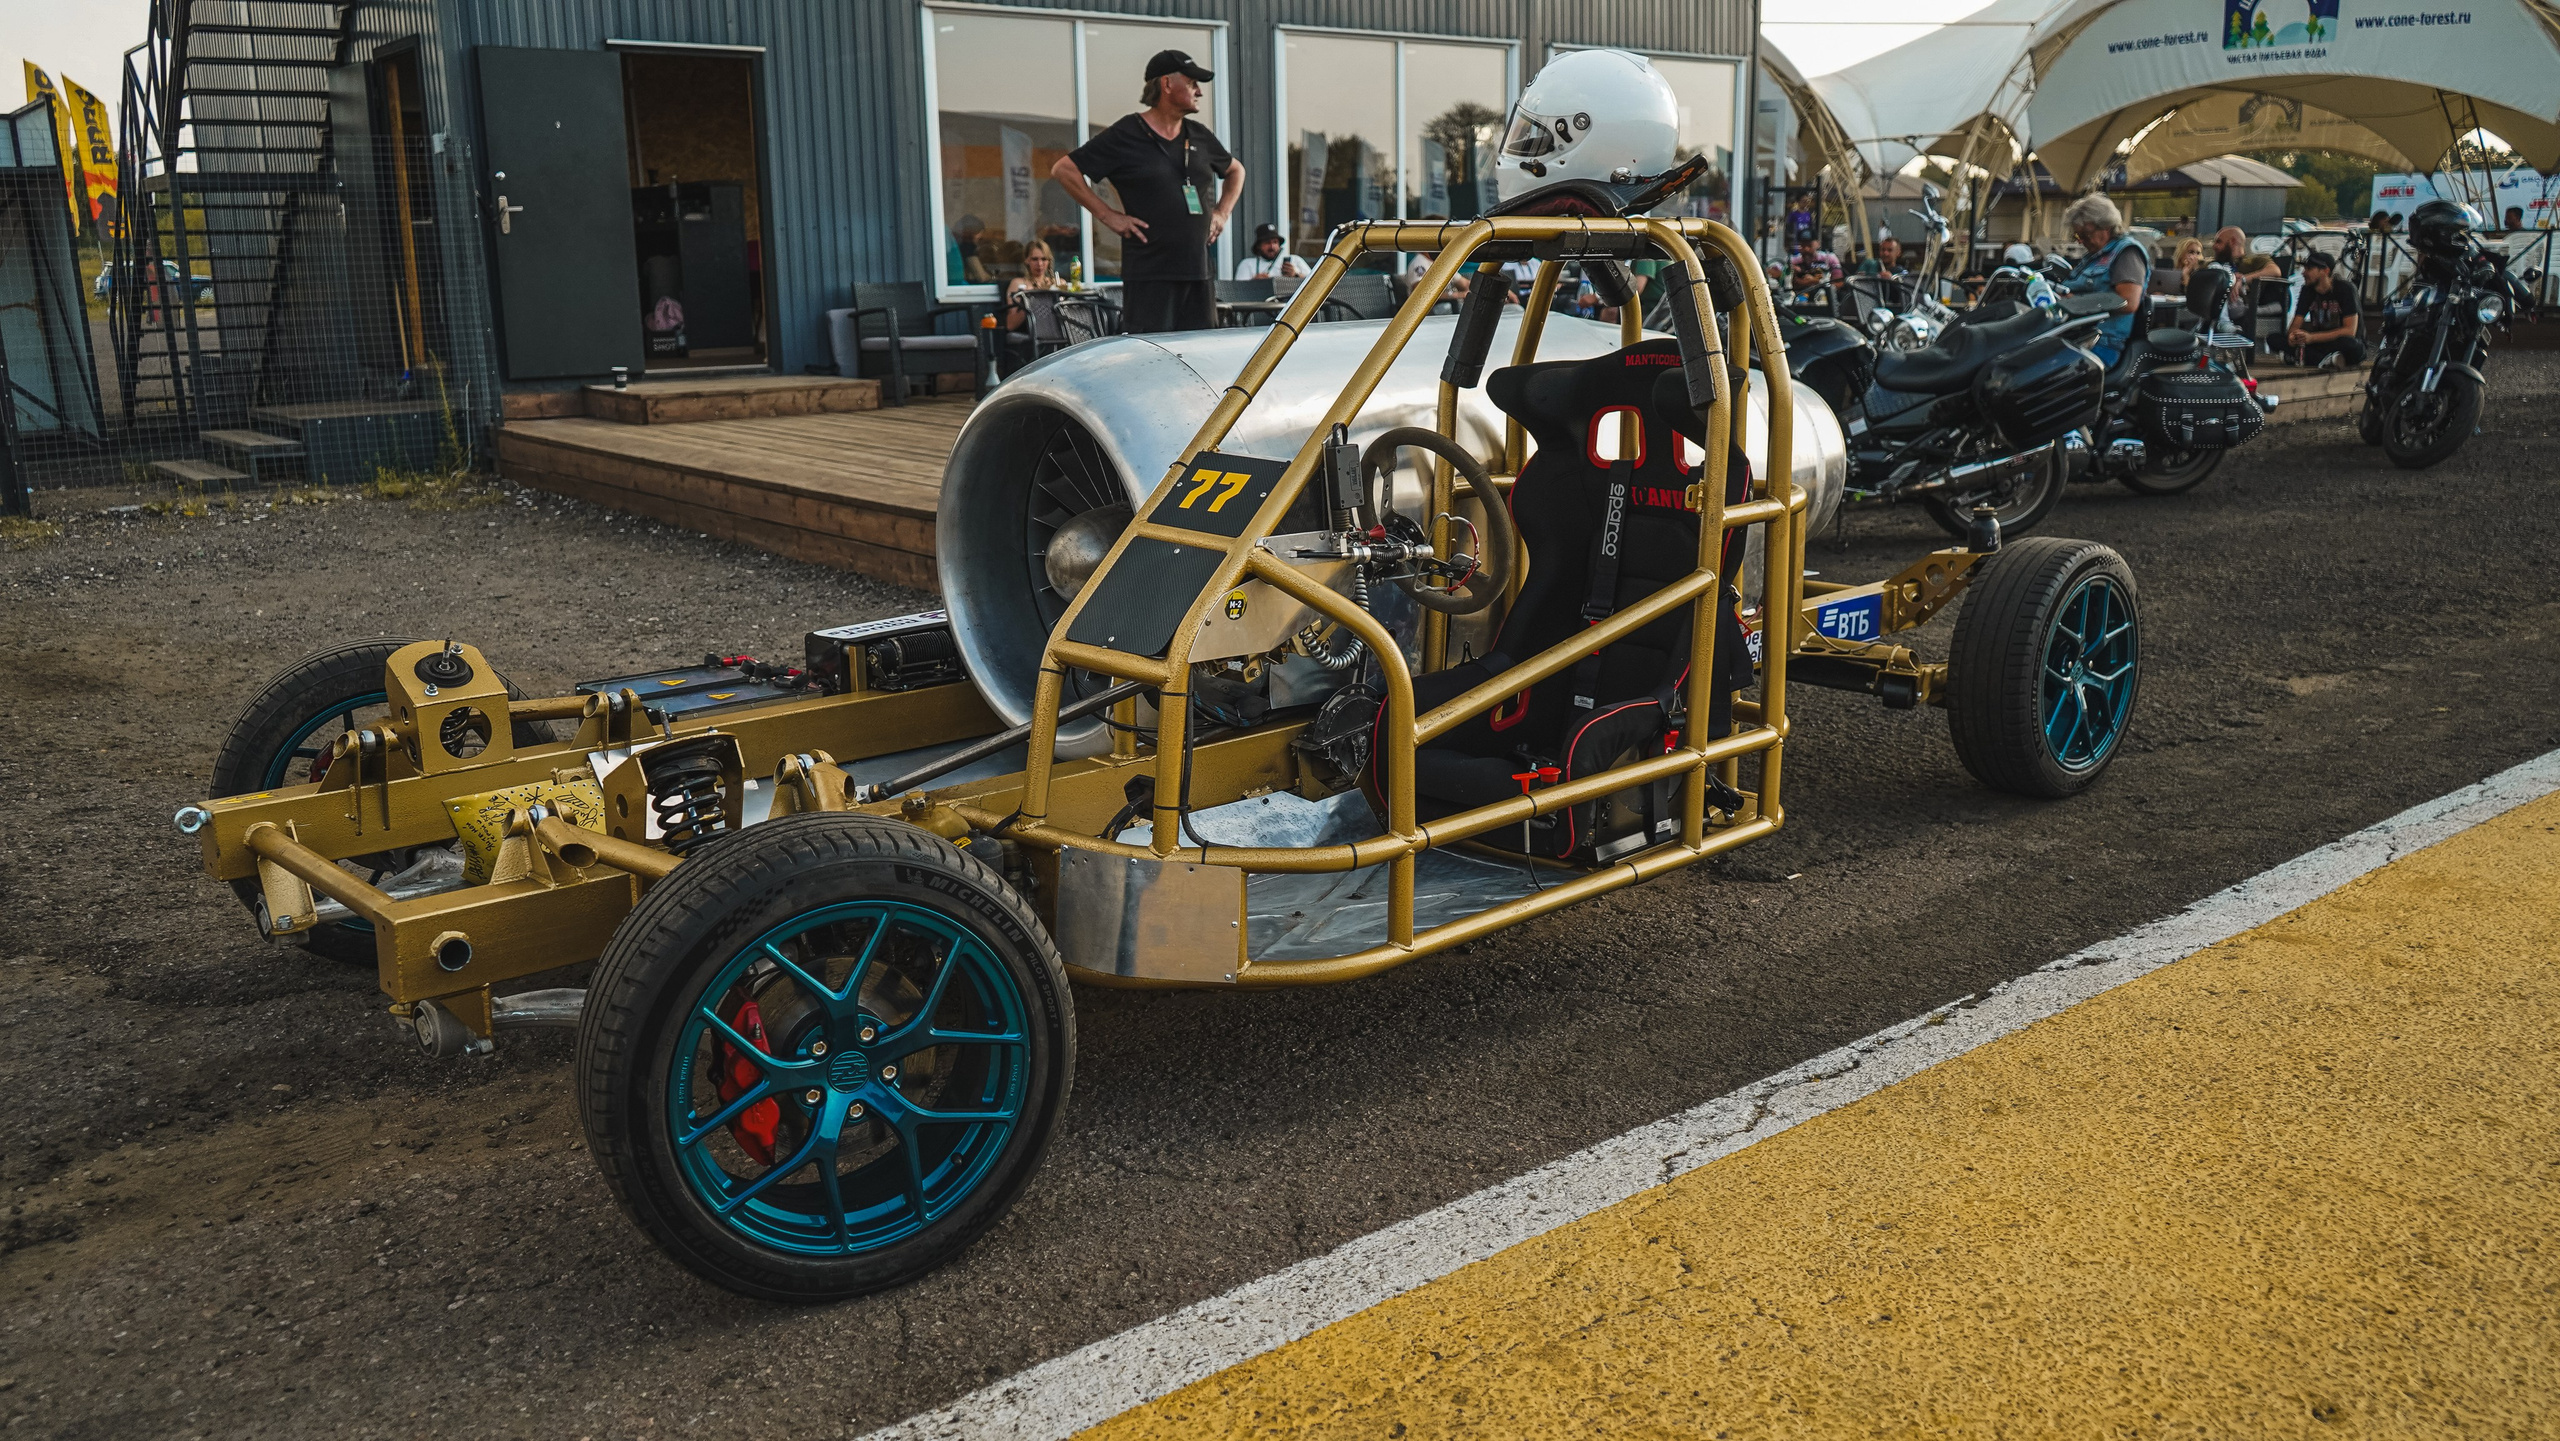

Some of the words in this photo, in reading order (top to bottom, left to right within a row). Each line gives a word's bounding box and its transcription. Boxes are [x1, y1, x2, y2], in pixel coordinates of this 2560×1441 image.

[2355, 11, 2471, 29] www.cone-forest.ru
[2108, 30, 2208, 54] www.cone-forest.ru
[2227, 53, 2257, 64] ЧИСТАЯ
[2259, 49, 2302, 62] ПИТЬЕВАЯ
[2304, 48, 2327, 59] ВОДА
[1625, 353, 1682, 366] MANTICORE
[1179, 469, 1252, 513] 77
[1838, 609, 1869, 638] ВТБ
[929, 876, 1023, 943] MICHELIN
[1027, 952, 1046, 981] PILOT
[1042, 983, 1058, 1019] SPORT
